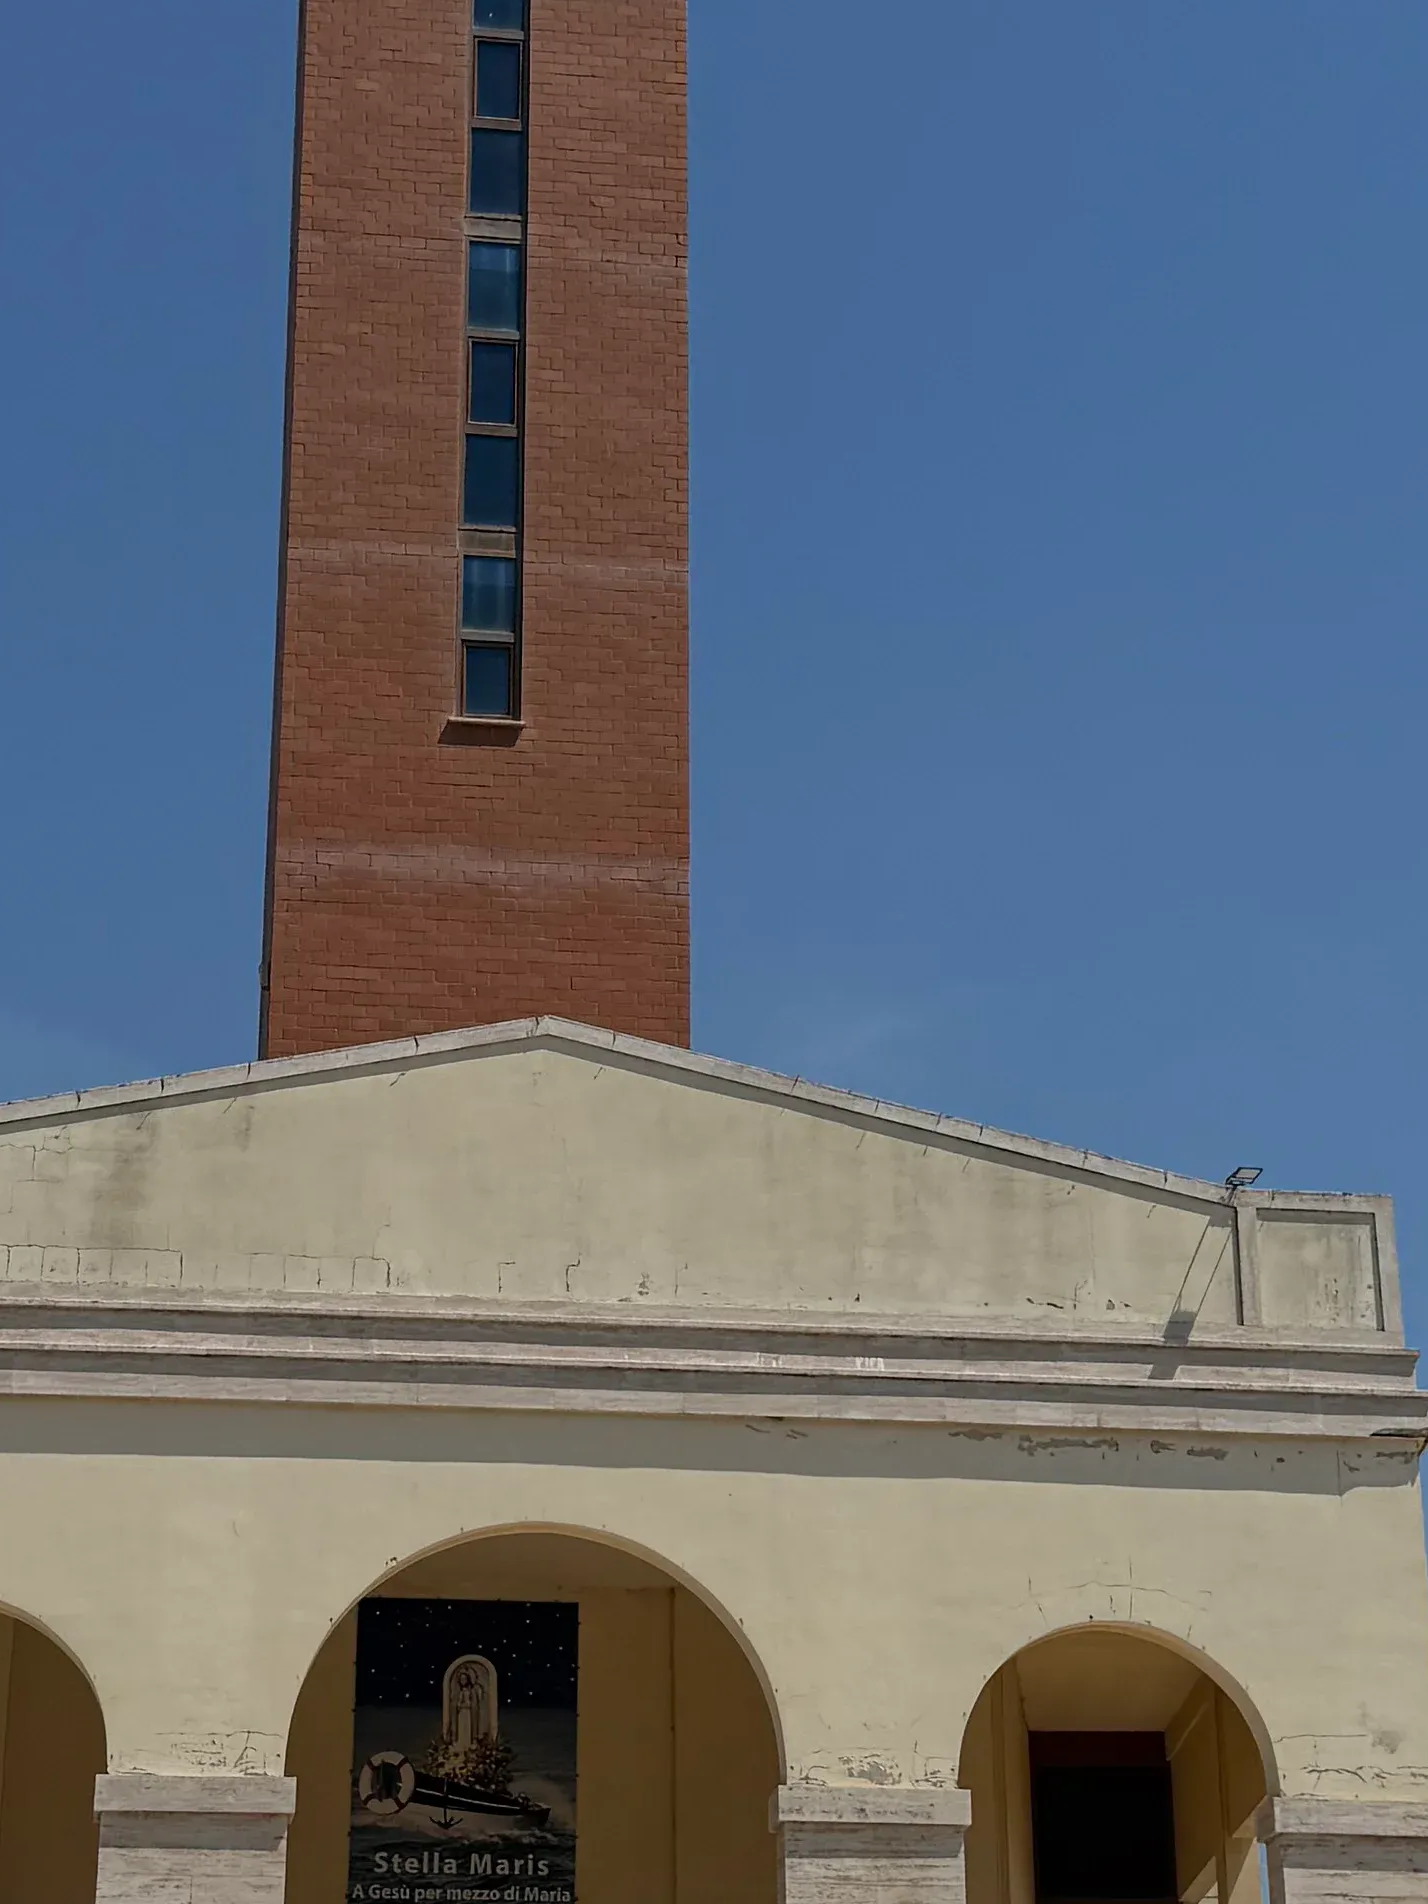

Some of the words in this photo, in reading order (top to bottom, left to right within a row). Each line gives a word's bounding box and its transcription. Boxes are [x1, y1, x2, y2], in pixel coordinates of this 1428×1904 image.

[373, 1851, 458, 1875] Stella
[469, 1853, 550, 1876] Maris
[352, 1884, 365, 1900] A
[368, 1883, 410, 1900] Gesù
[415, 1887, 443, 1904] per
[446, 1888, 501, 1902] mezzo
[503, 1885, 521, 1903] di
[524, 1886, 571, 1903] Maria
